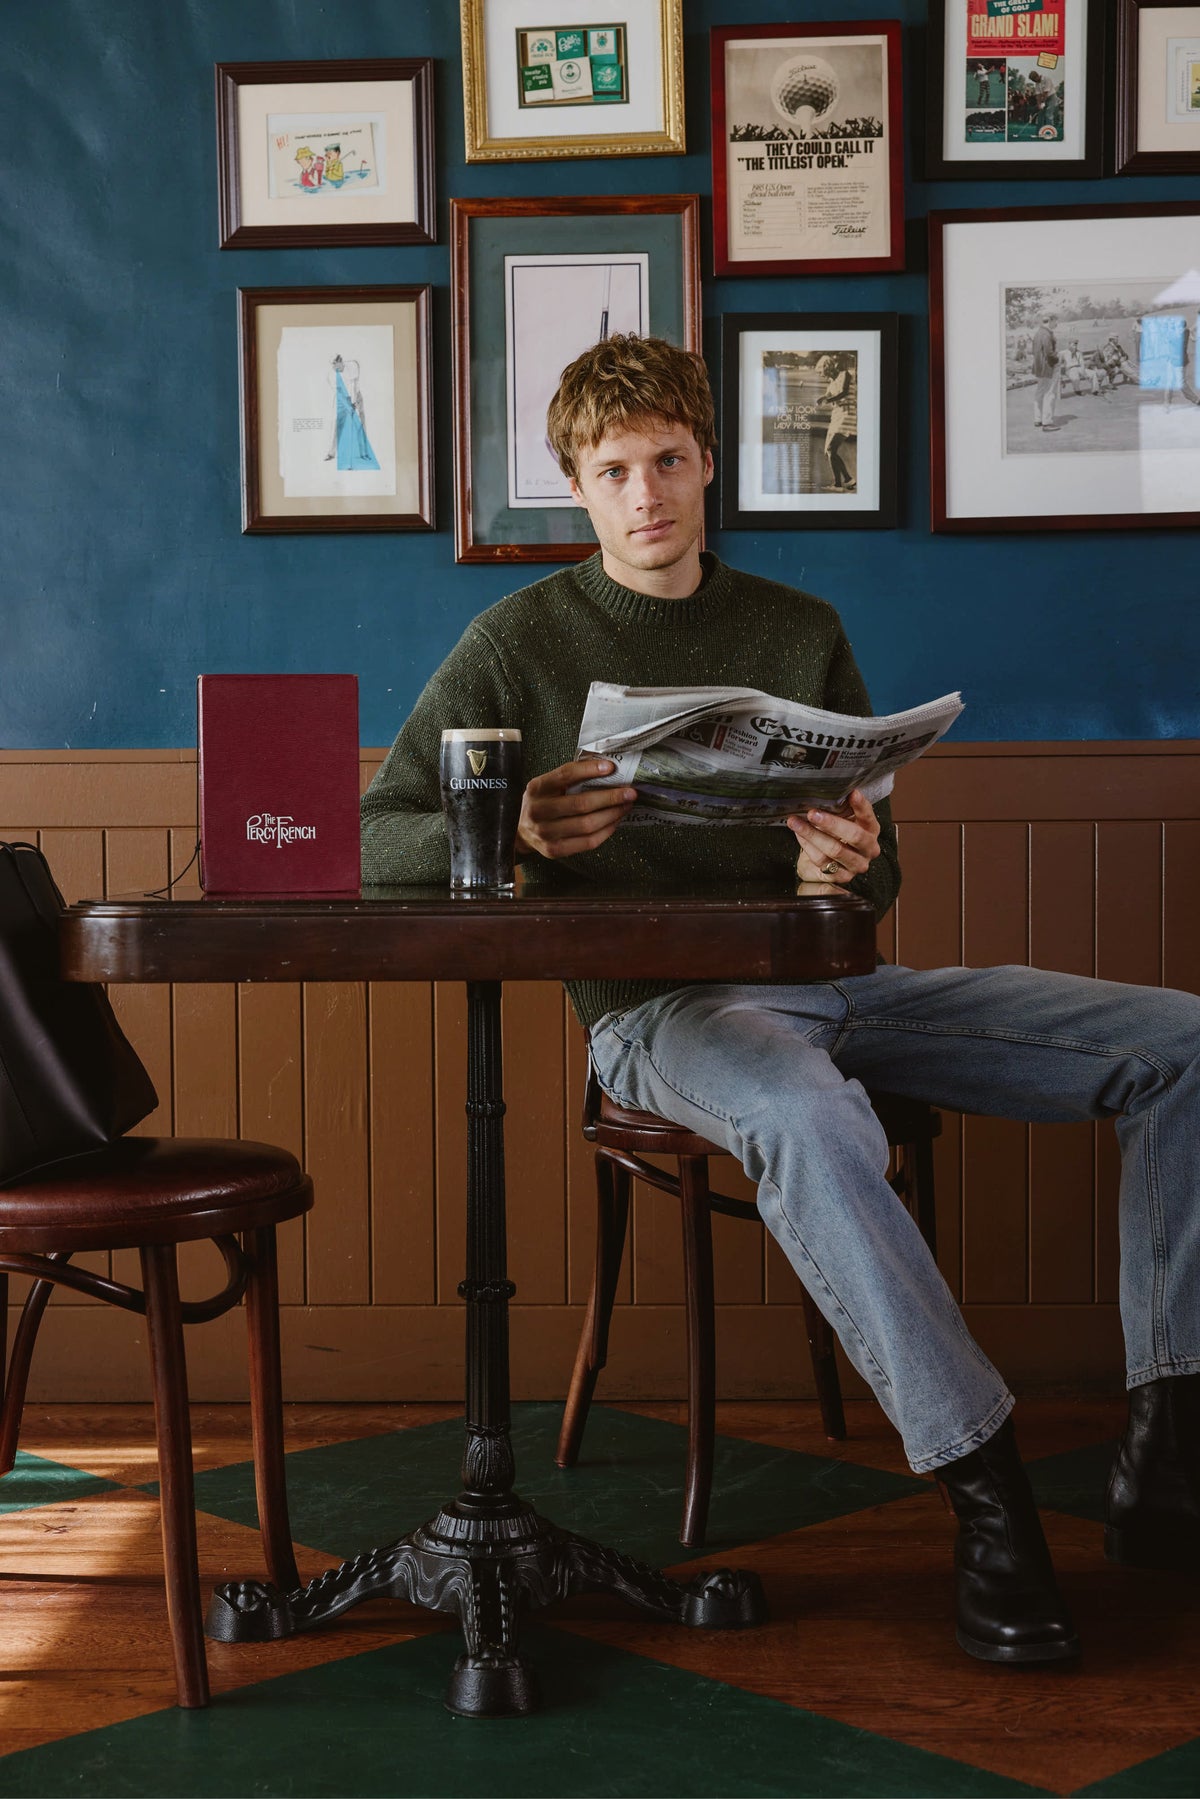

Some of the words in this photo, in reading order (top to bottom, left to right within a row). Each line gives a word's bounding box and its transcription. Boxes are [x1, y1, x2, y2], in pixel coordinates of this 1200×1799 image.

[993, 1, 1007, 9] THE
[1011, 4, 1030, 12] GOLF
[971, 14, 1014, 38] GRAND
[1017, 13, 1059, 37] SLAM!
[765, 142, 793, 156] THEY
[796, 141, 832, 155] COULD
[834, 140, 862, 154] CALL
[864, 140, 874, 154] IT
[767, 155, 814, 170] TITLEIST
[832, 224, 867, 236] Titleist
[795, 405, 817, 414] LOOK
[777, 413, 793, 421] FOR
[794, 413, 808, 422] THE
[773, 421, 792, 430] LADY
[793, 421, 811, 430] PROS
[727, 731, 759, 747] forward
[729, 726, 758, 741] Fashion
[750, 716, 907, 749] Examiner
[450, 777, 508, 790] GUINNESS
[261, 812, 276, 827] THE
[246, 814, 277, 844] PERCY
[276, 816, 316, 849] FRENCH
